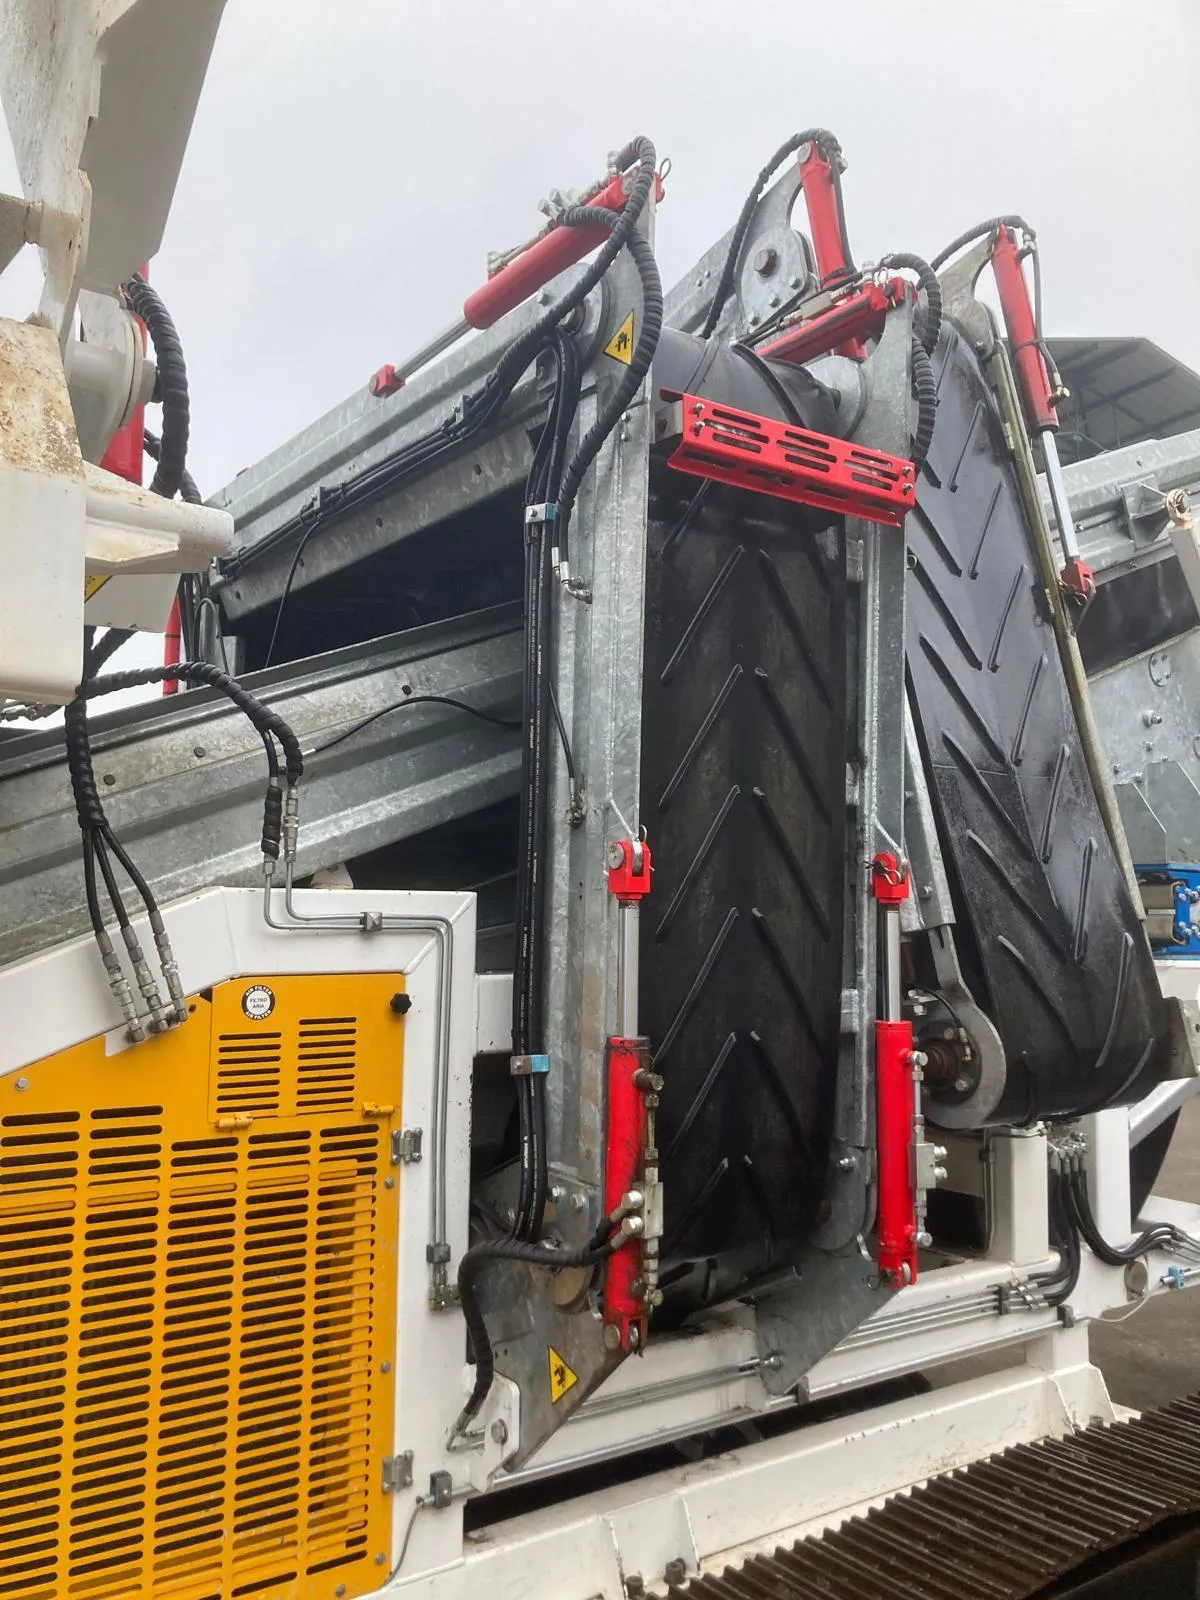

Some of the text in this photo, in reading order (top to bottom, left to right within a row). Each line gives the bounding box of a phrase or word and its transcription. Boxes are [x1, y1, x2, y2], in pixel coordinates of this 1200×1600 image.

[246, 986, 272, 996] AIR FILTER
[254, 1010, 271, 1019] FILTER
